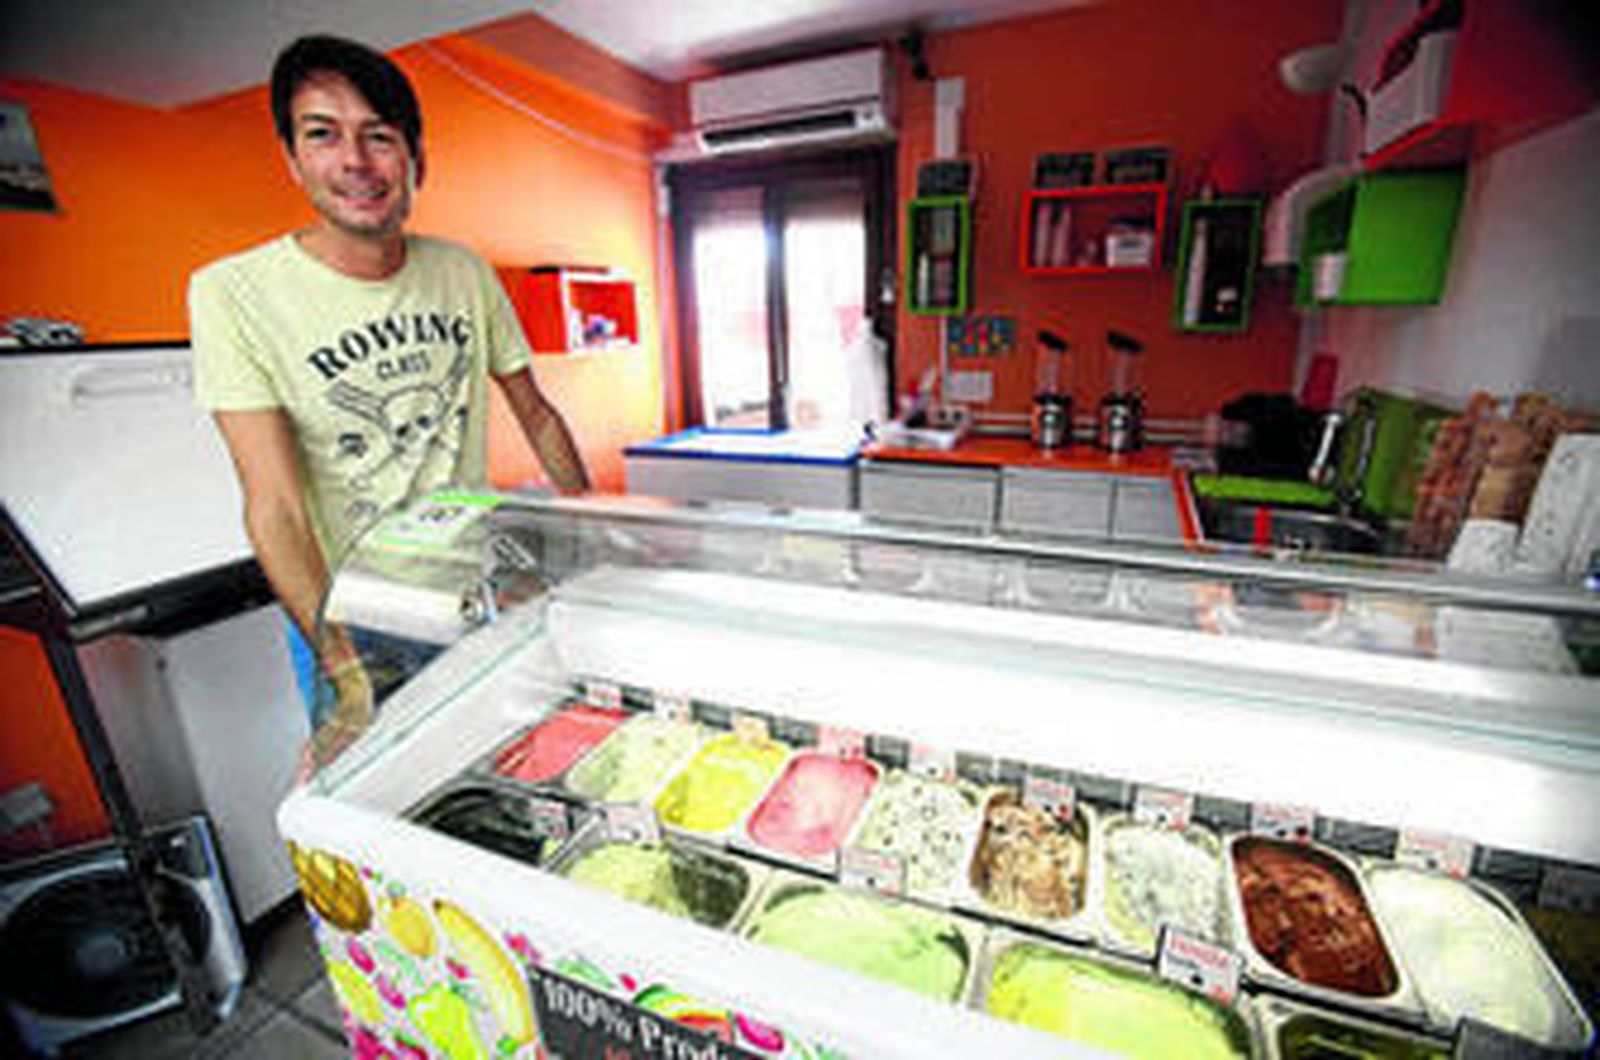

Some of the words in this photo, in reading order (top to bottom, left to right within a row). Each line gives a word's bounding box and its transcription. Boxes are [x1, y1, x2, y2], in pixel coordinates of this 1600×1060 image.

[307, 313, 469, 379] ROWING
[543, 976, 632, 1042] 100%
[638, 1015, 728, 1060] Prod
